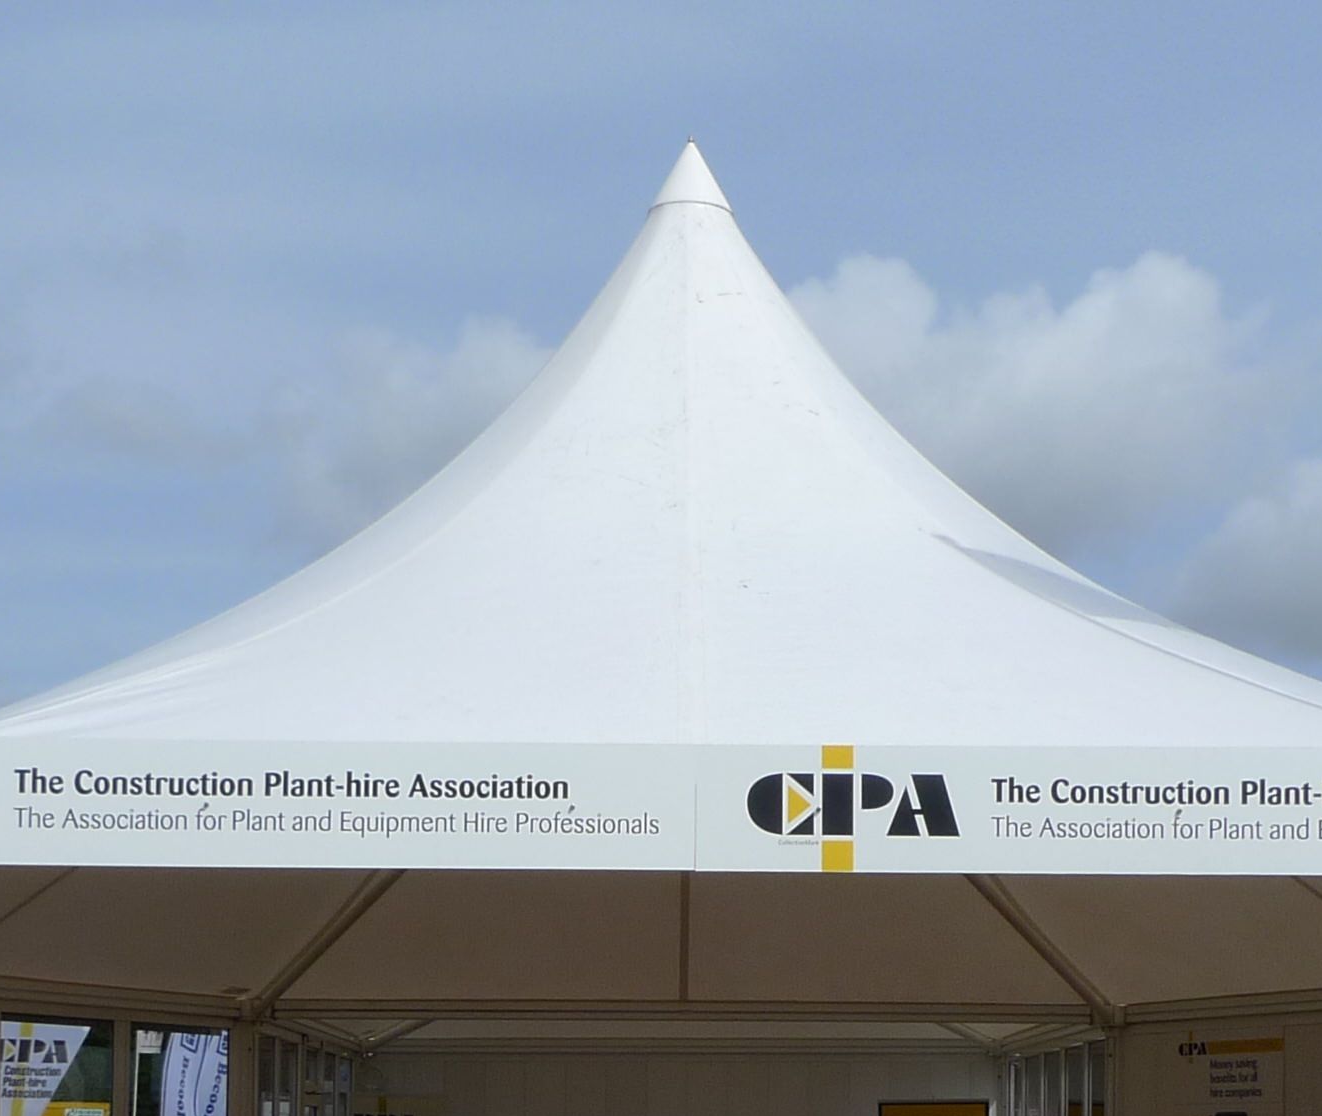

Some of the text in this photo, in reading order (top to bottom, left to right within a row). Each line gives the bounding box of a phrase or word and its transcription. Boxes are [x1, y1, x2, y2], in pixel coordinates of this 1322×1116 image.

[14, 767, 569, 800] The Construction Plant-hire Association
[991, 777, 1040, 804] The
[1050, 778, 1230, 806] Construction
[746, 773, 960, 837] CPA
[14, 807, 660, 838] The Association for Plant and Equipment Hire Professionals
[991, 816, 1033, 839] The
[1039, 817, 1165, 840] Association
[1172, 817, 1204, 841] for
[1209, 818, 1263, 841] Plant
[1269, 819, 1310, 842] and
[4, 1065, 61, 1077] Construction
